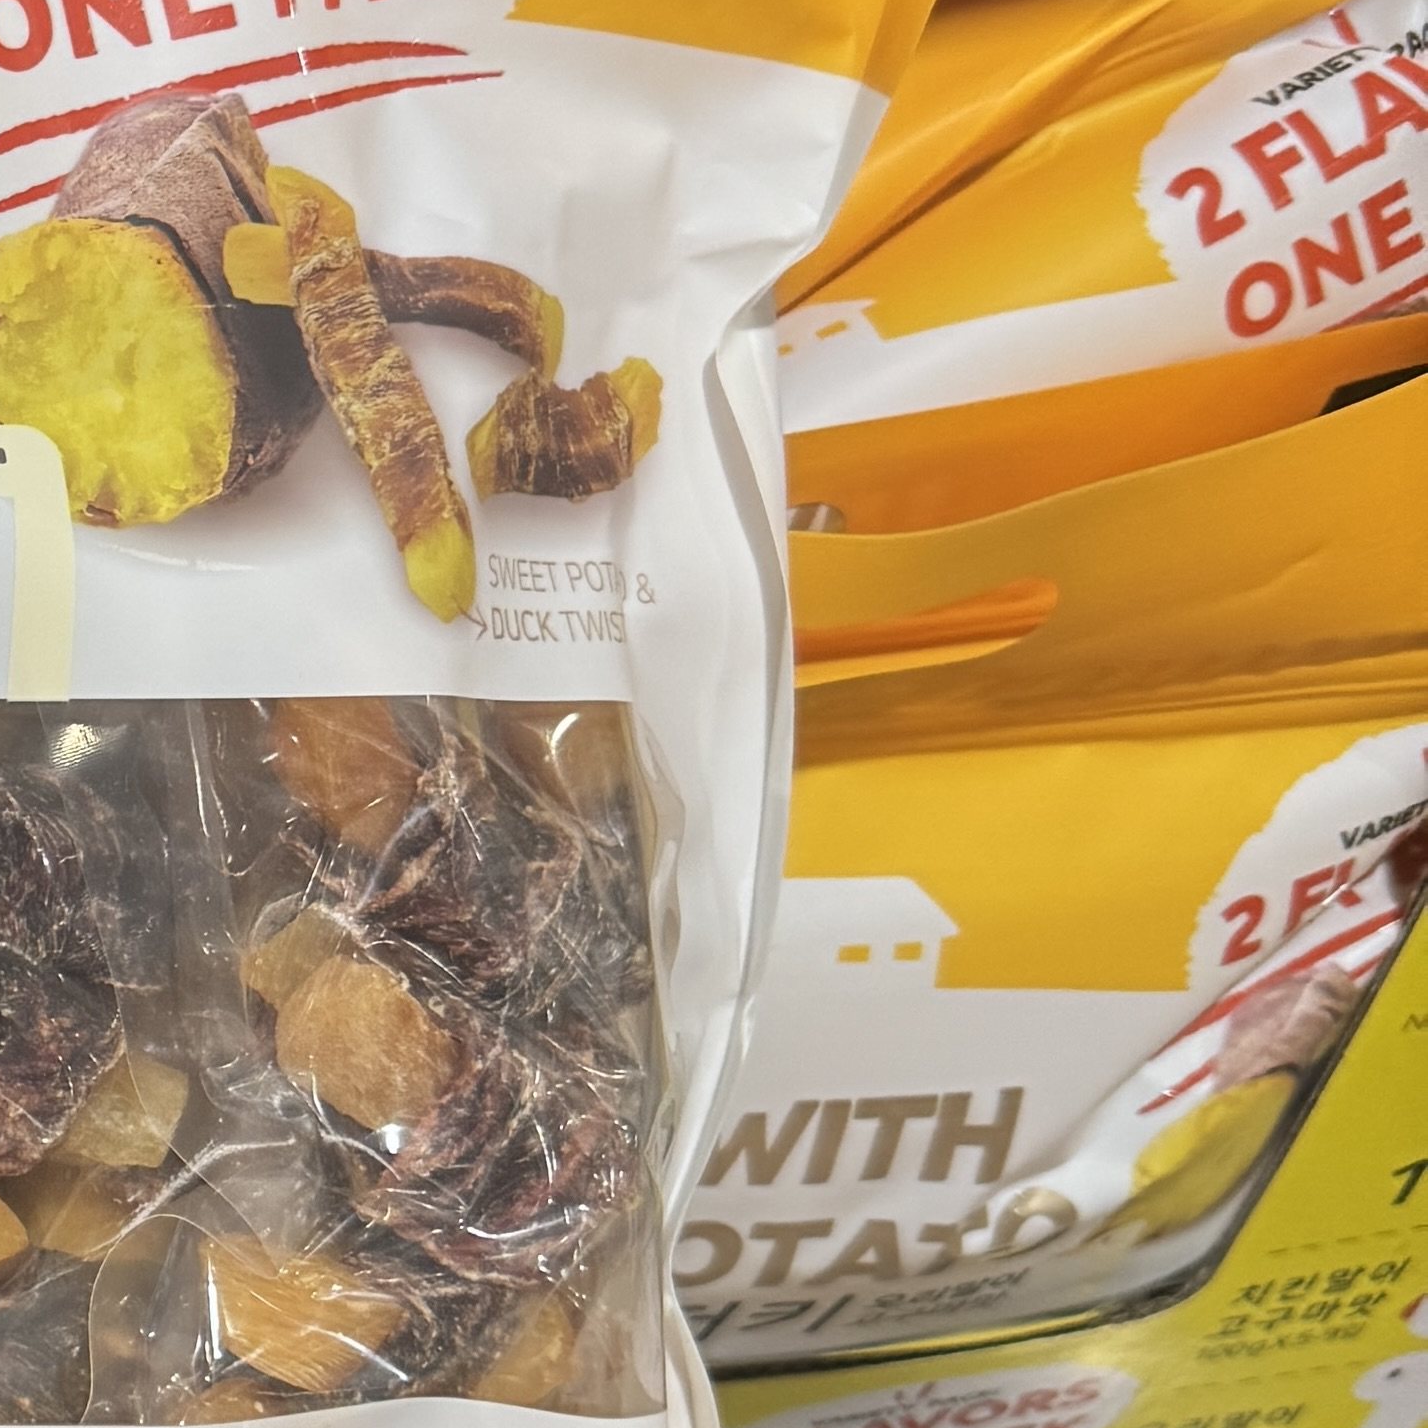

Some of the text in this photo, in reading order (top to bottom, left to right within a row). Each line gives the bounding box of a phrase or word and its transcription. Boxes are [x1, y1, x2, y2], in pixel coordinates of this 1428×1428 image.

[1163, 166, 1248, 249] 2
[1224, 177, 1426, 339] ONE
[487, 553, 559, 593] SWEET
[491, 606, 559, 643] DUCK
[1219, 893, 1266, 967] 2
[696, 1085, 1025, 1187] WITH
